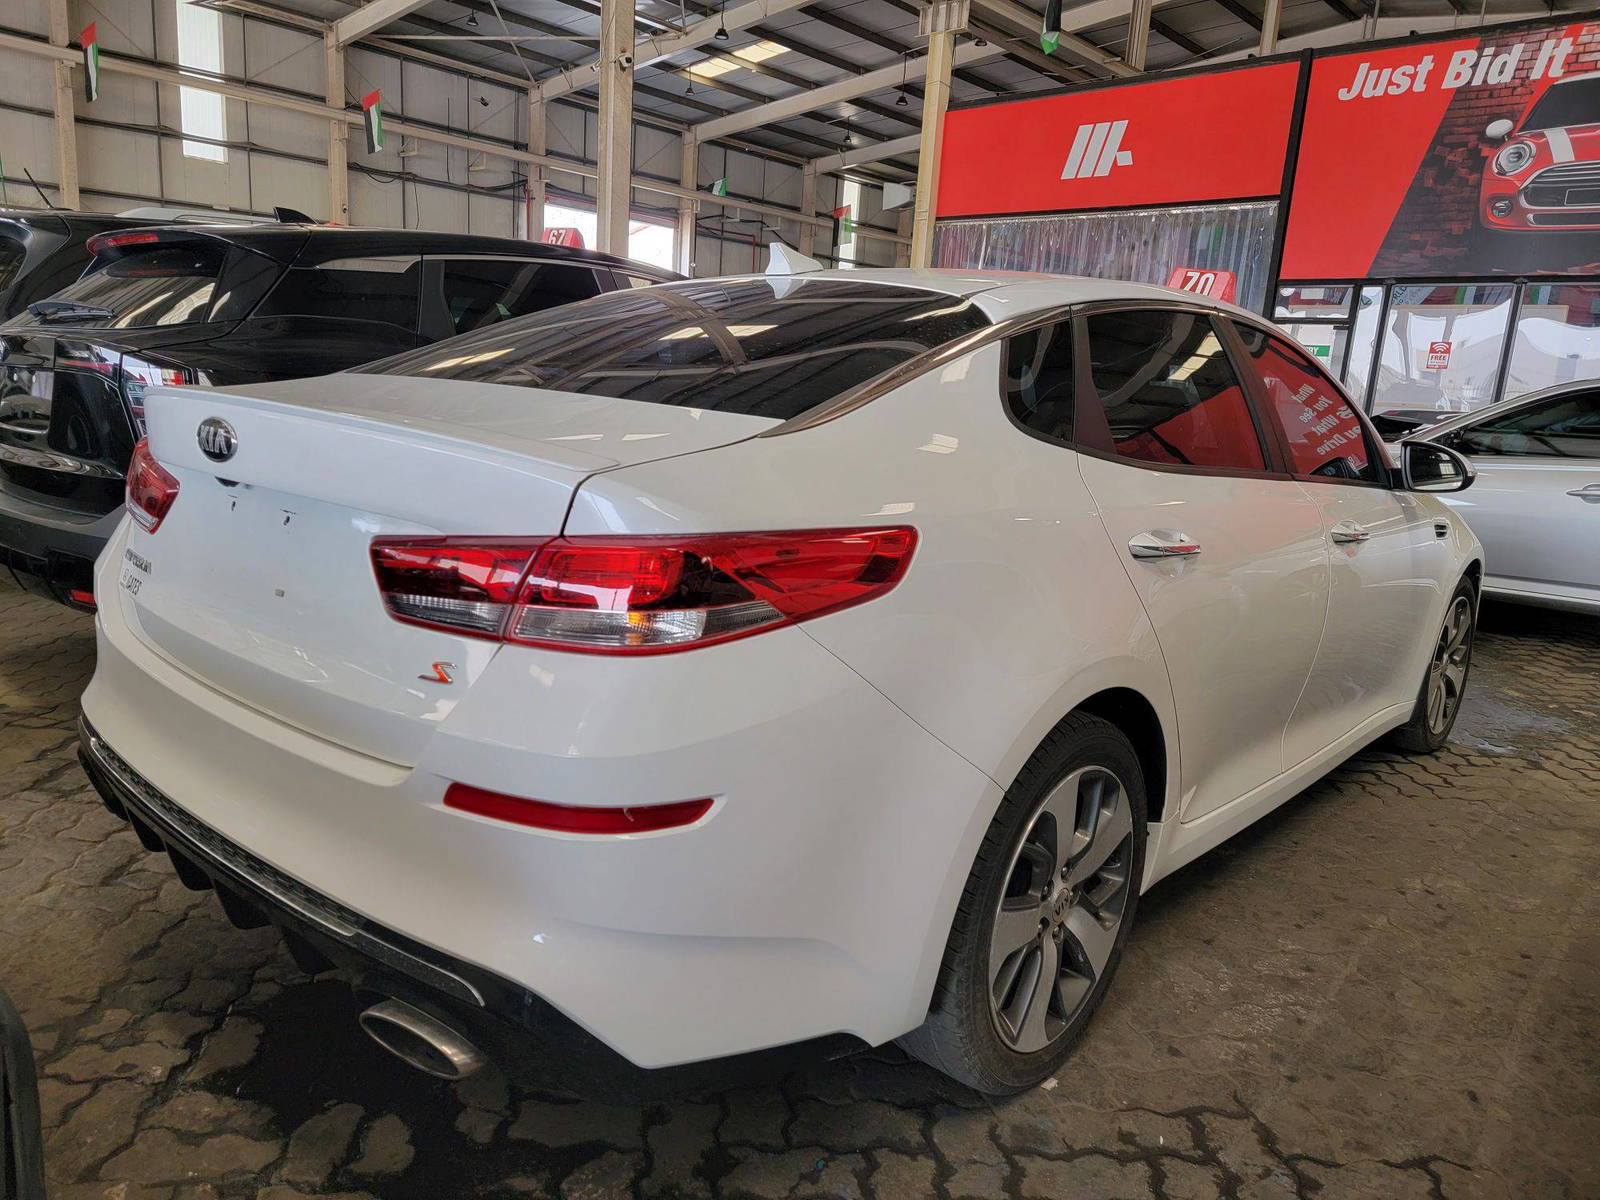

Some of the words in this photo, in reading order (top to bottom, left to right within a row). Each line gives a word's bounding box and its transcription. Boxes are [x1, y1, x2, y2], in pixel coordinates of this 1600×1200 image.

[1338, 55, 1434, 100] Just
[1441, 43, 1523, 89] Bid
[1530, 37, 1574, 80] It
[548, 229, 567, 246] 67
[1183, 271, 1214, 297] 70
[200, 425, 228, 454] KIA
[417, 661, 457, 685] S
